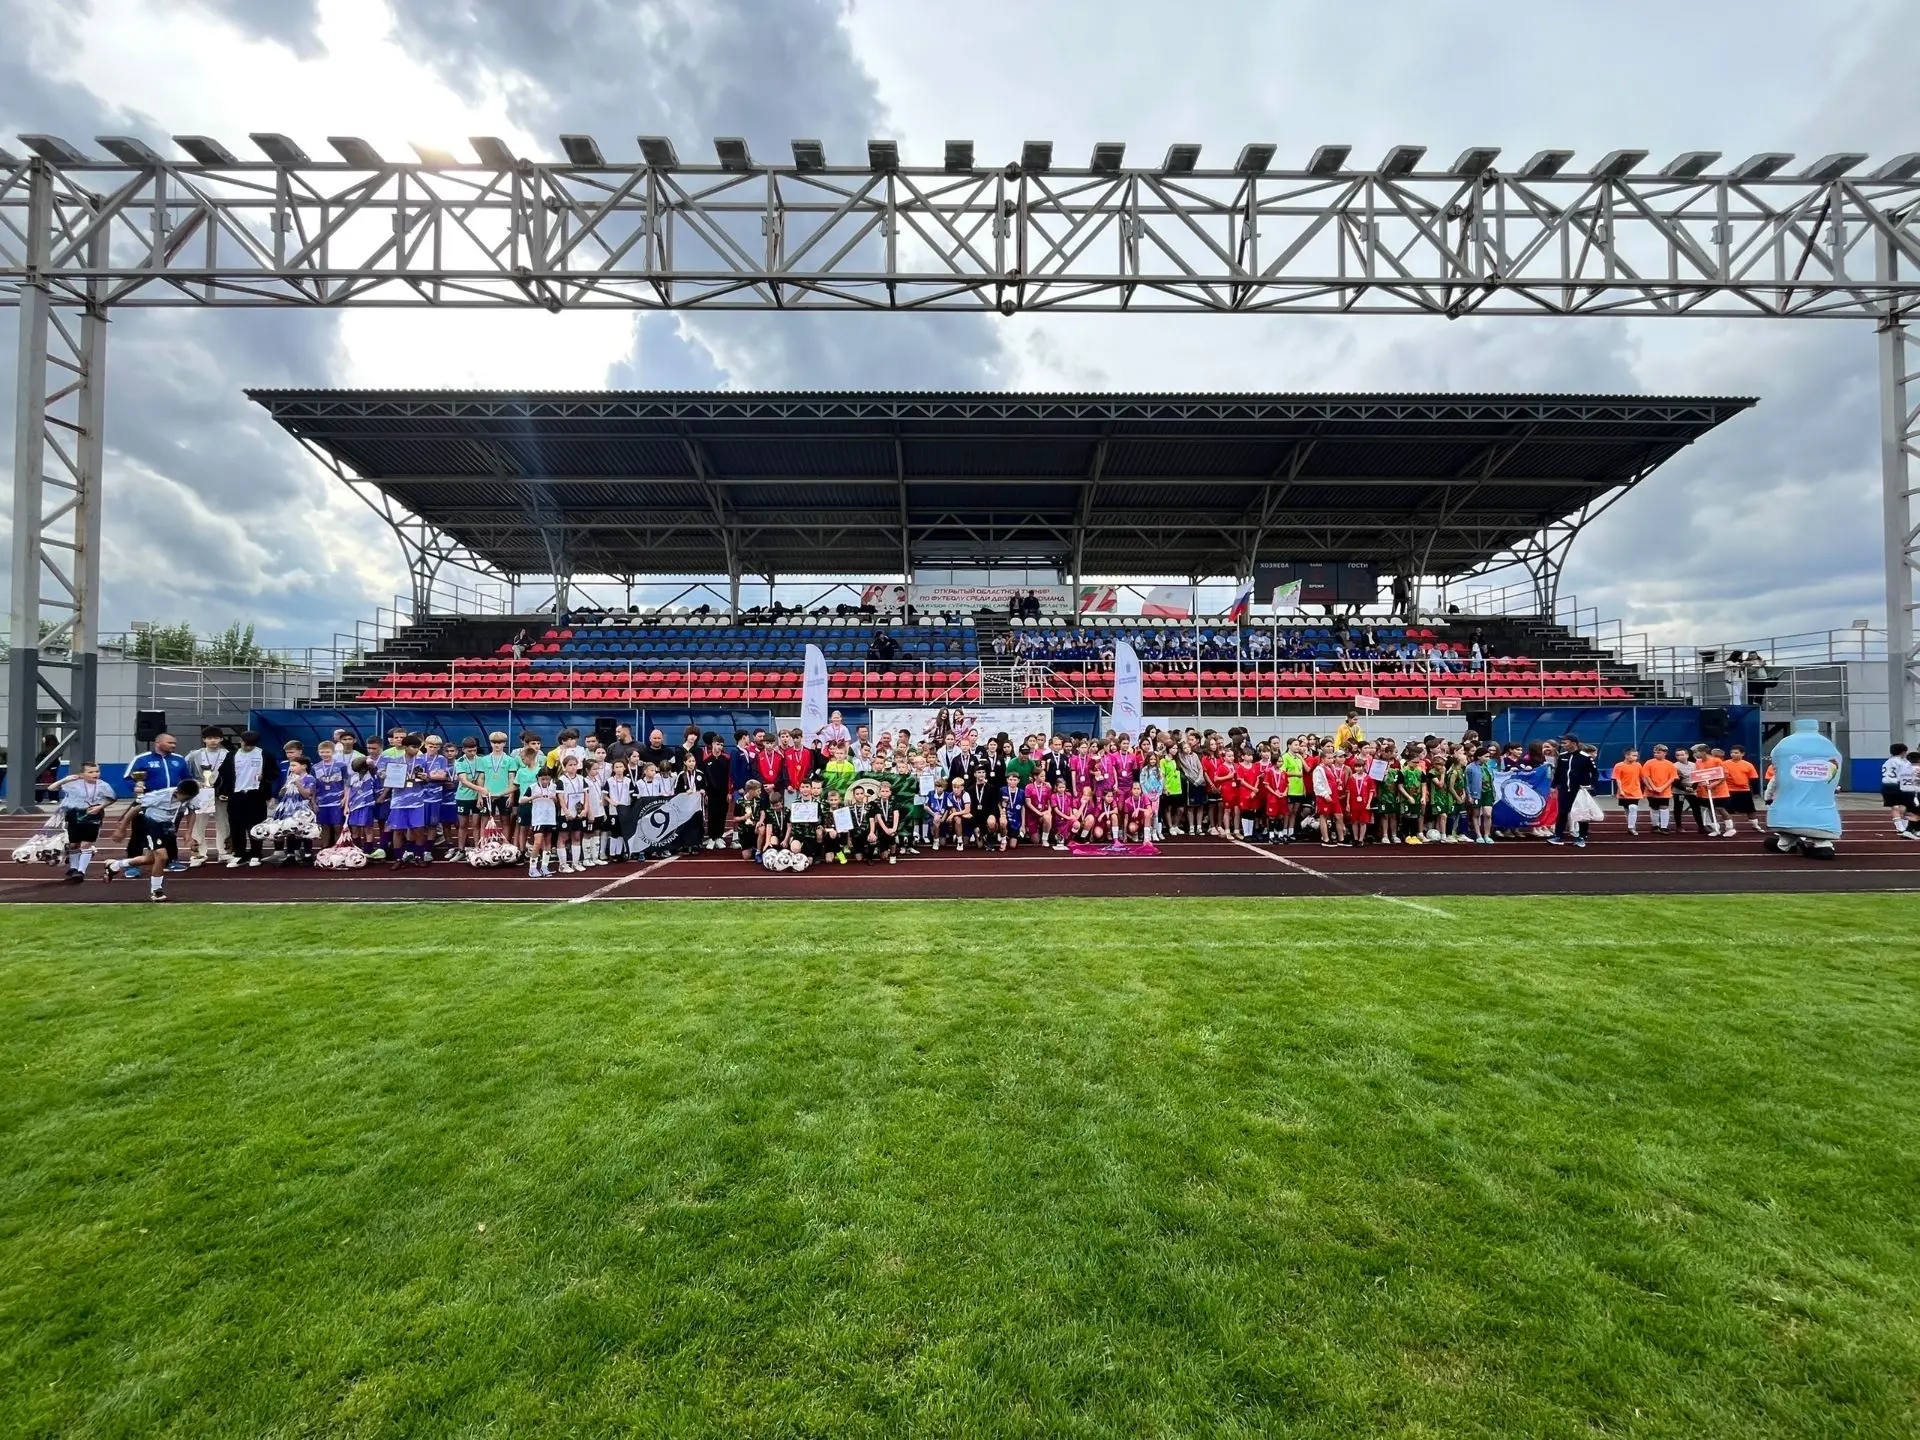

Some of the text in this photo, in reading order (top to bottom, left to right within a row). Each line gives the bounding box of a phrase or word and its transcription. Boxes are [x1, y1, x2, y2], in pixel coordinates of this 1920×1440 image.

[934, 587, 976, 595] ОТКРЫТЫЙ
[1881, 766, 1897, 778] 23
[650, 808, 670, 838] 9
